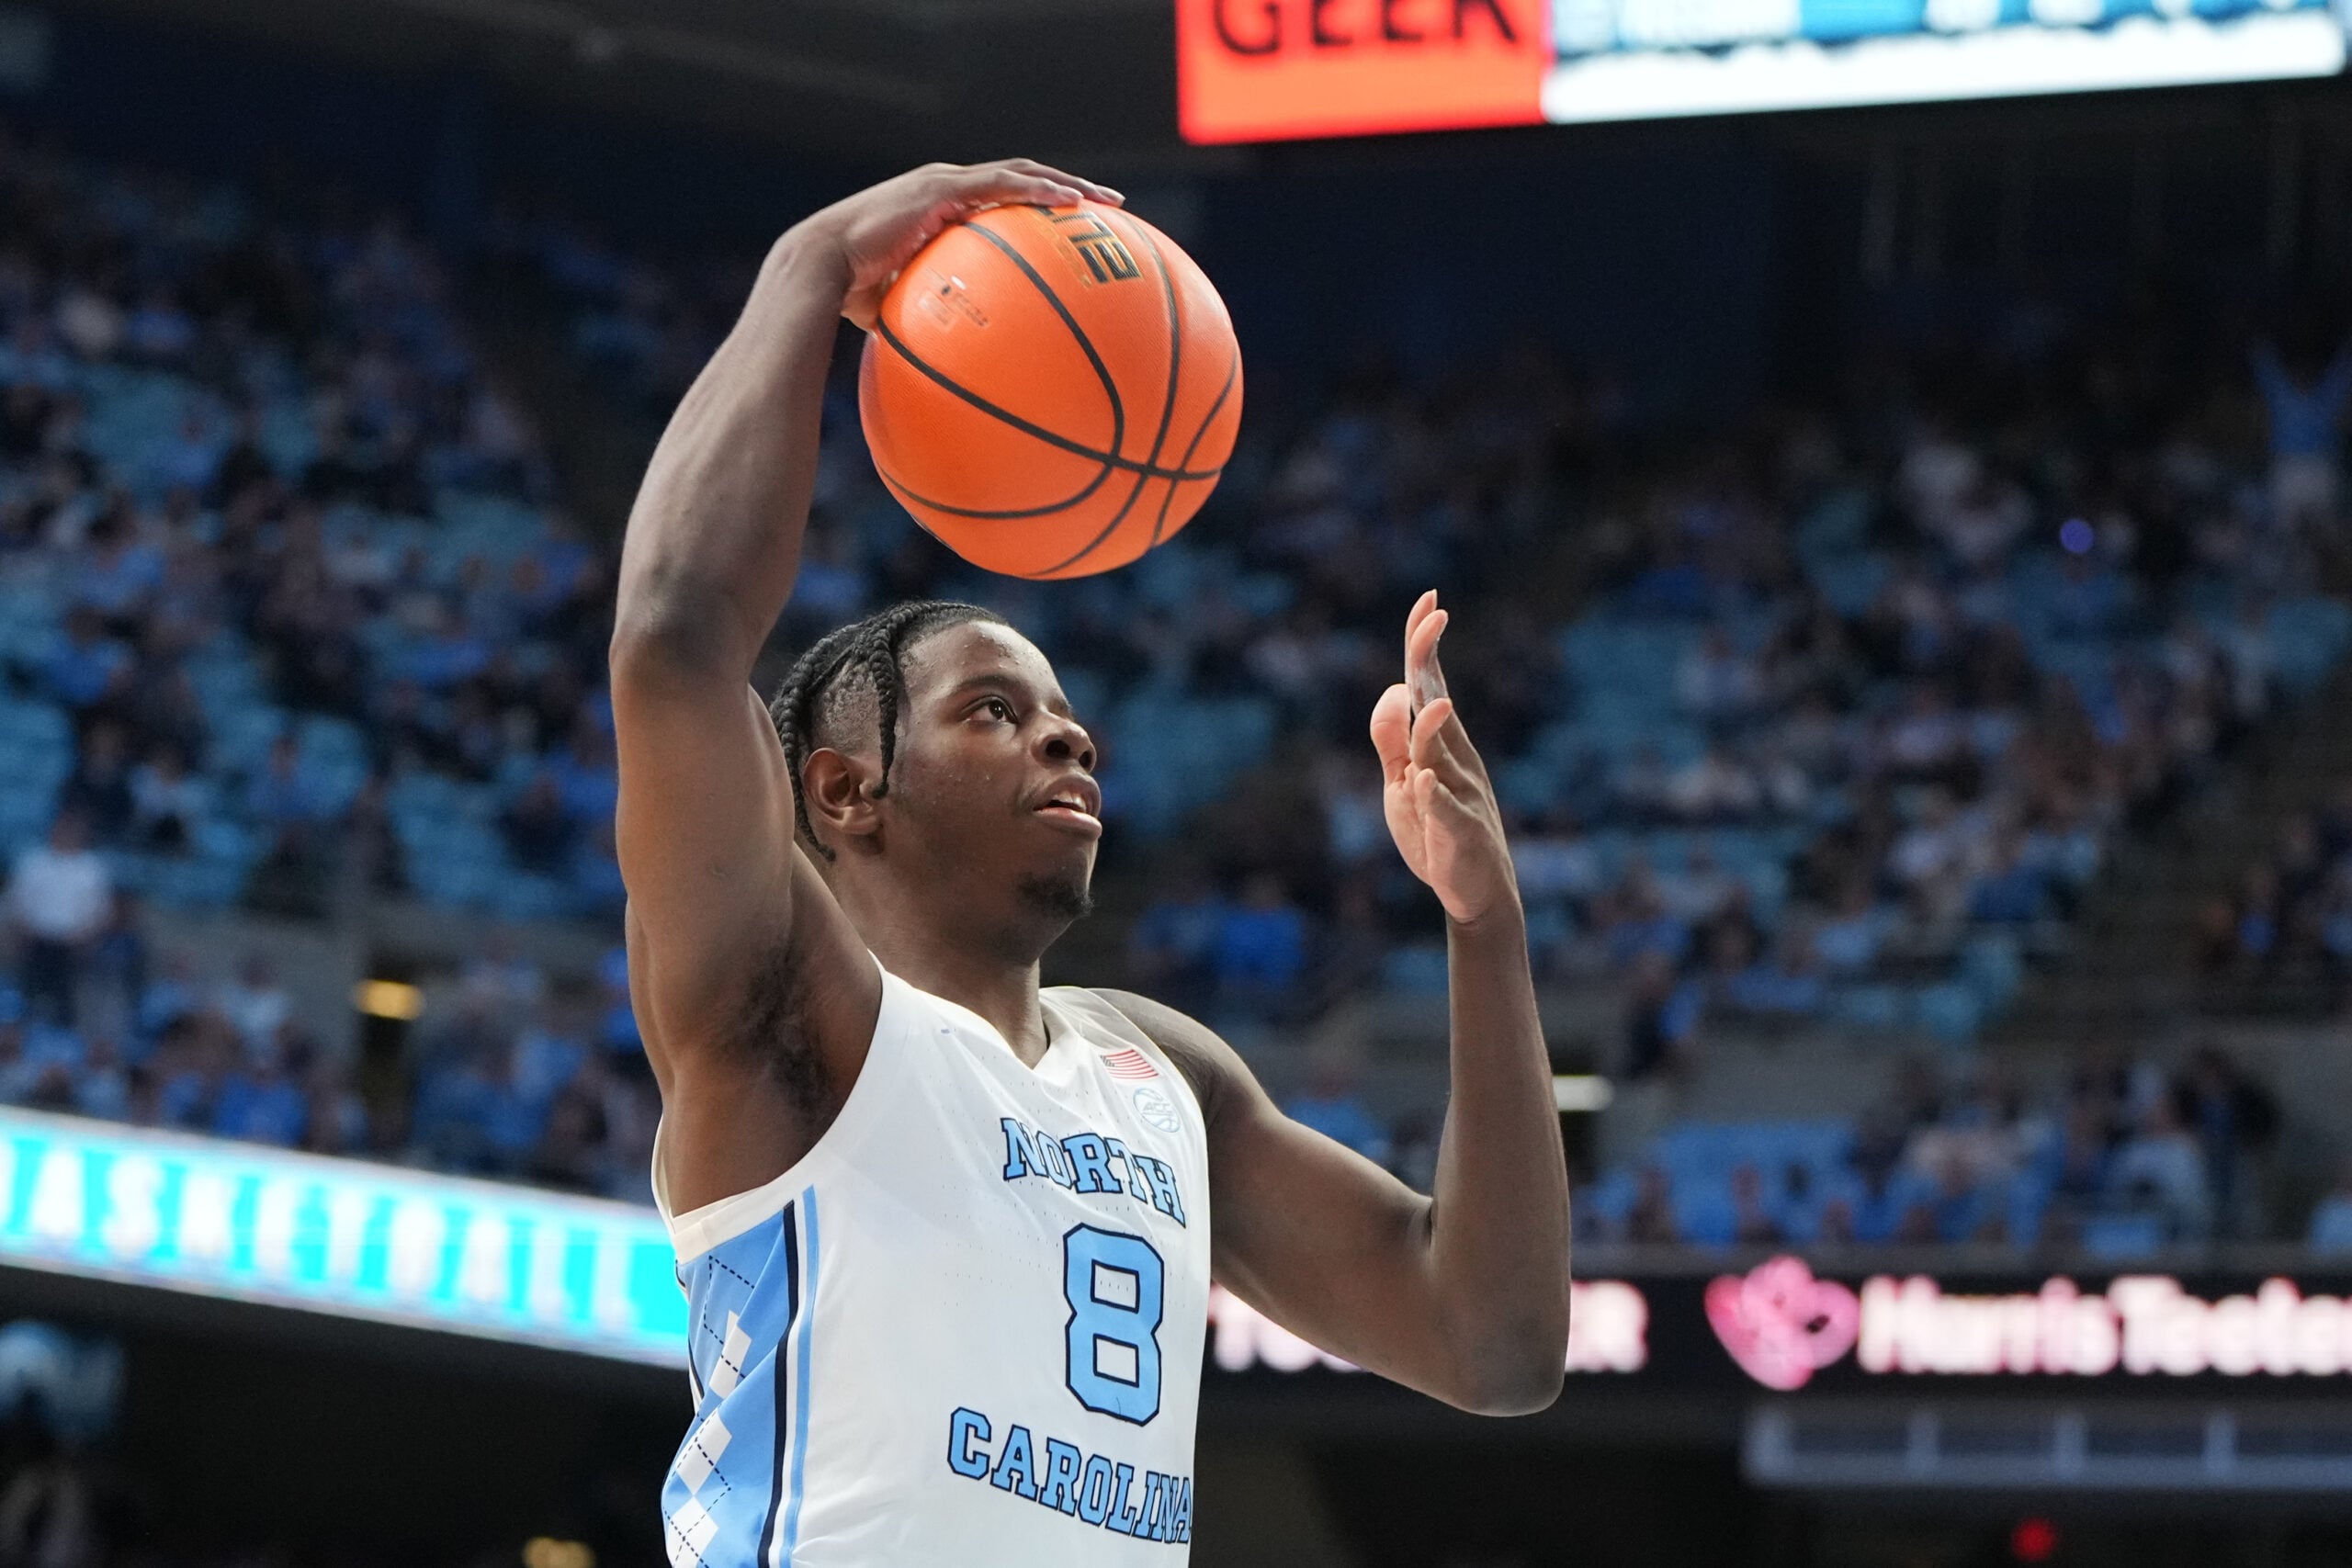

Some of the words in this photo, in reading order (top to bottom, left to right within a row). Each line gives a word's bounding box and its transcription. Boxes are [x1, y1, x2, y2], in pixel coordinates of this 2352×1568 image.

[0, 1134, 636, 1337] ASKETBALL
[1000, 1117, 1186, 1227] NORTH
[1063, 1223, 1165, 1427] 8
[947, 1406, 1193, 1544] CAROLINA
